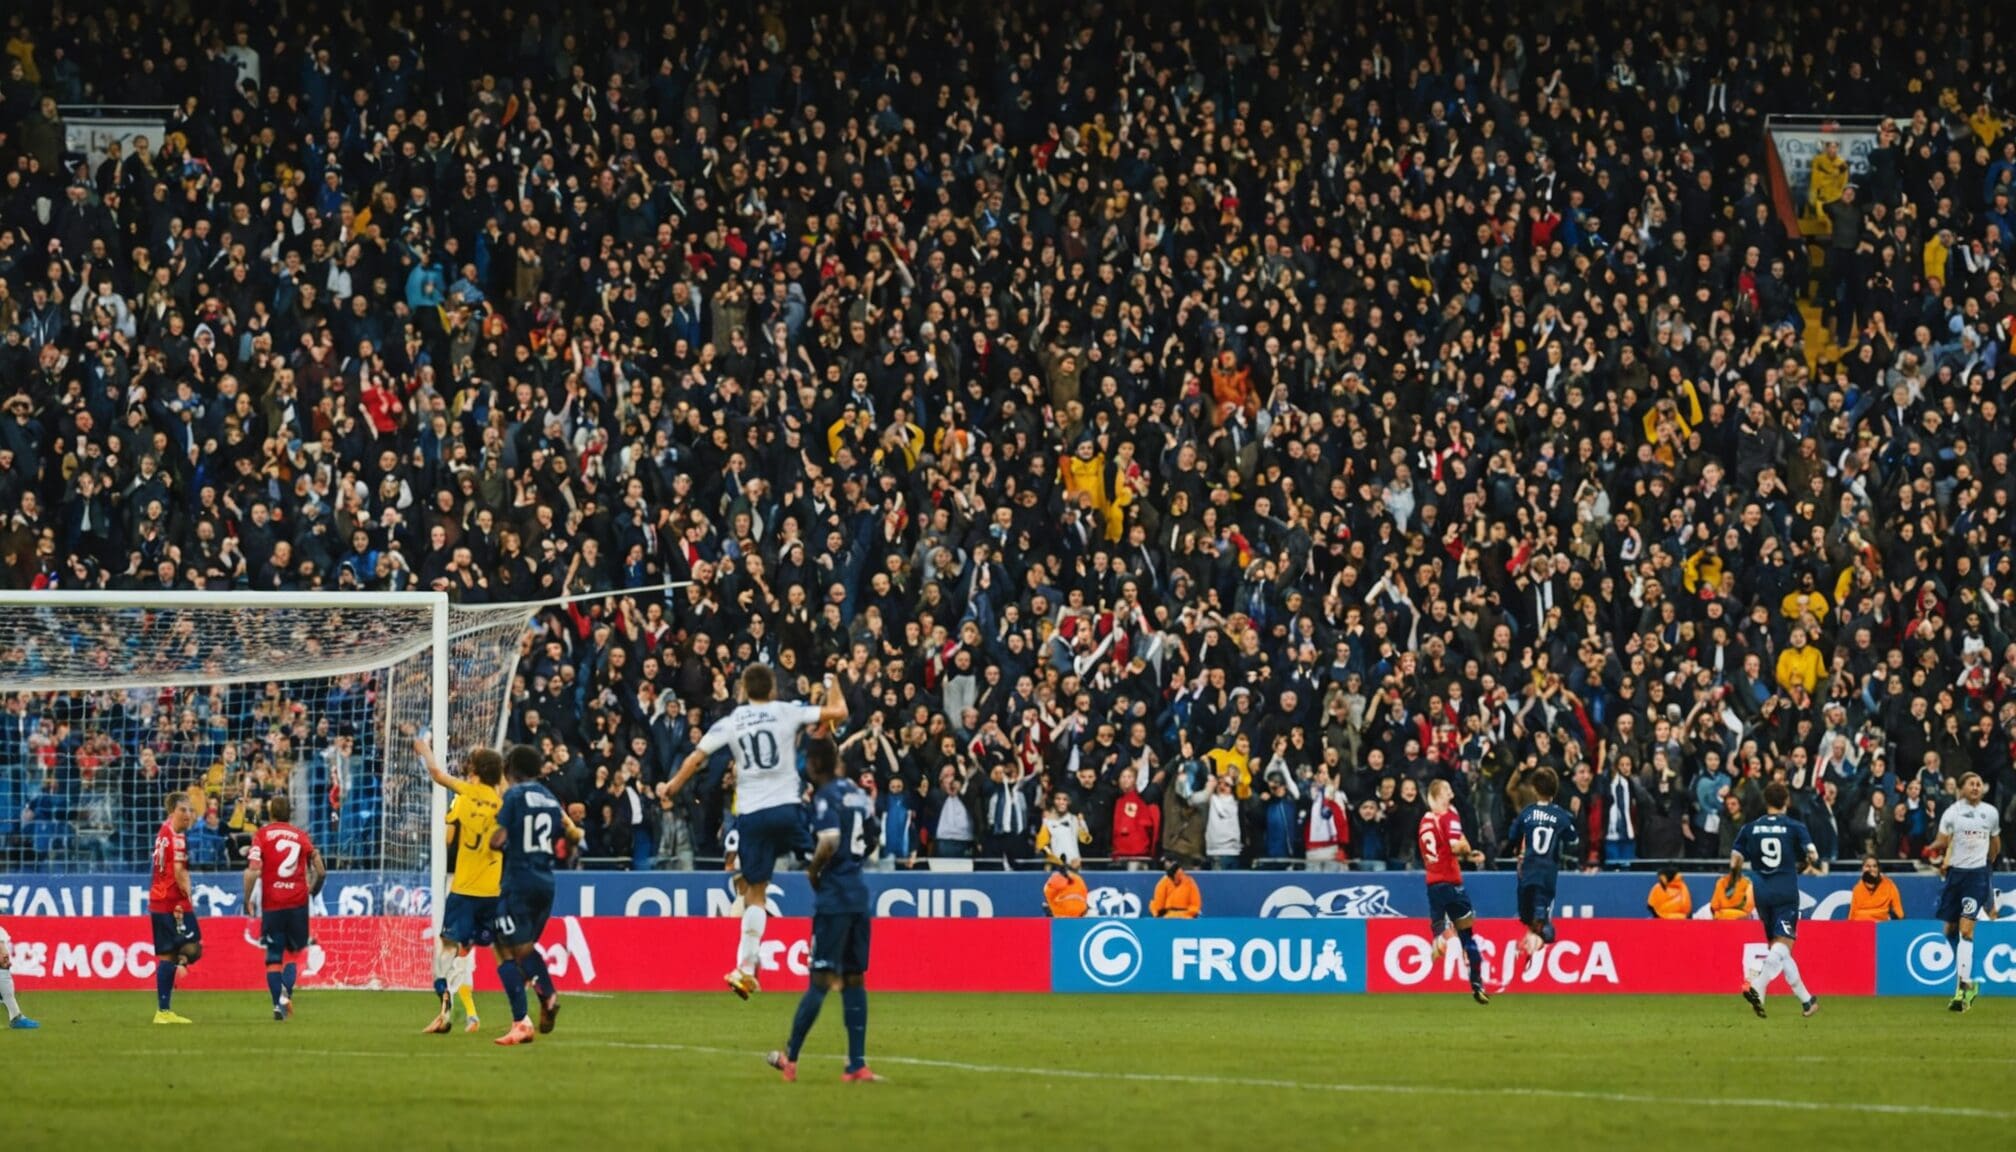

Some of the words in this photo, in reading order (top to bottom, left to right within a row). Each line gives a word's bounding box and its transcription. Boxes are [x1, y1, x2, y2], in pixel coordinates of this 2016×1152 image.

[738, 729, 780, 770] 10
[275, 838, 301, 878] 2
[1760, 837, 1782, 868] 9
